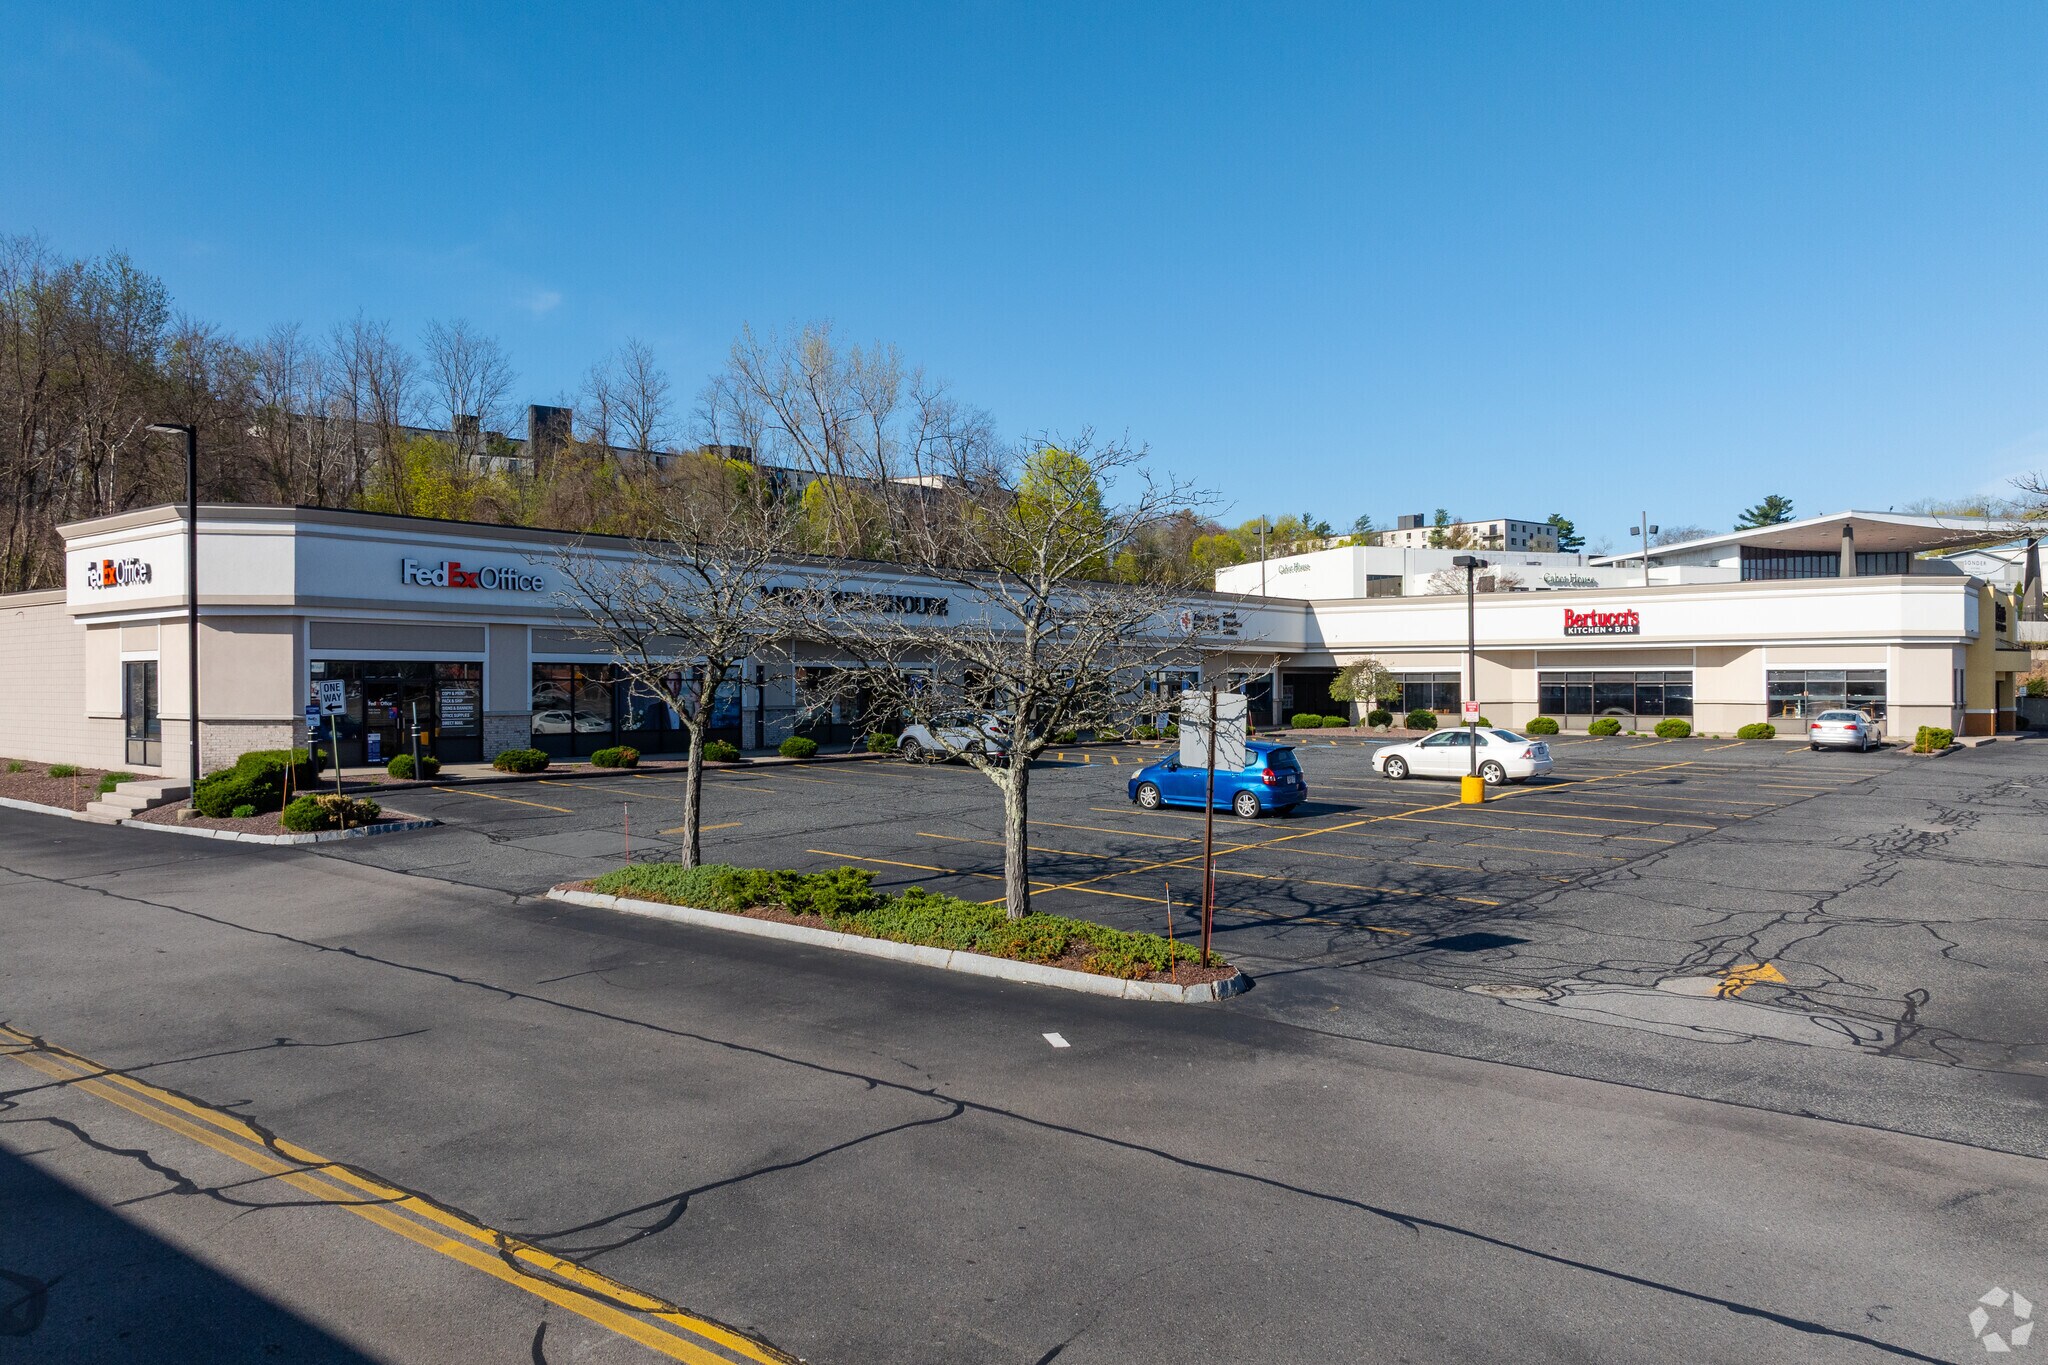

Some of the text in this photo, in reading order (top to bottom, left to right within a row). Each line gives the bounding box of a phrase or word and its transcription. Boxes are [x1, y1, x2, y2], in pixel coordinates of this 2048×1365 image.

[402, 558, 545, 593] FedEx Office
[1563, 608, 1640, 627] Bertucci's
[1568, 626, 1606, 634] KITCHEN
[323, 683, 340, 693] ONE
[323, 693, 341, 702] WAY
